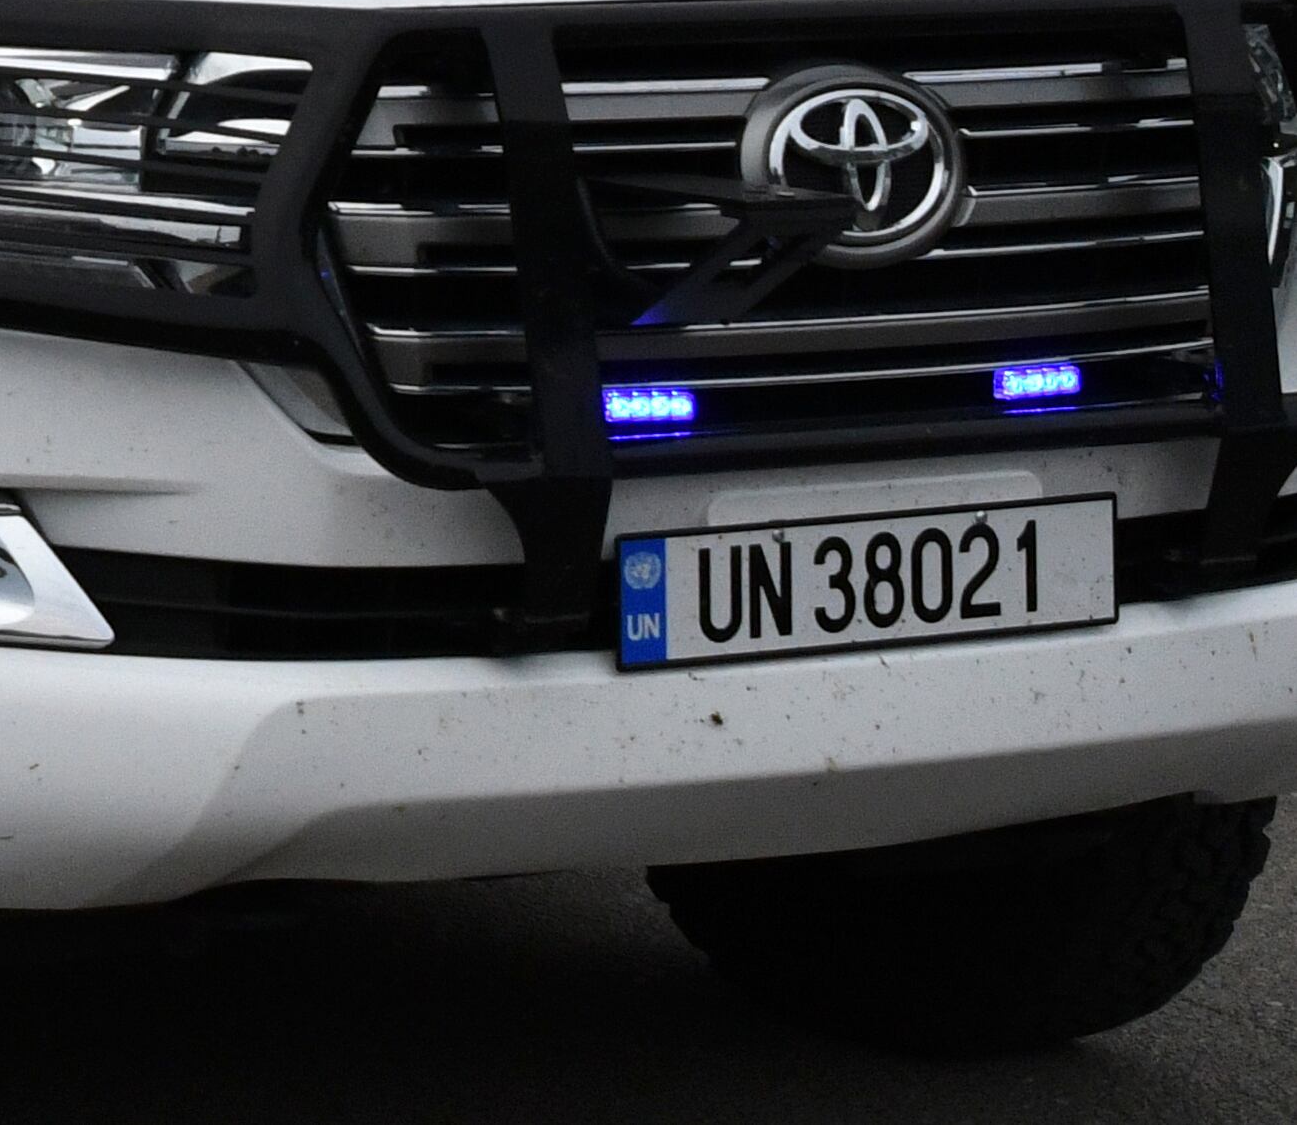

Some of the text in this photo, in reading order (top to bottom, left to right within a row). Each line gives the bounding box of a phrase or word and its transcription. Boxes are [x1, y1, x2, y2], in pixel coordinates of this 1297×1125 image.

[698, 518, 1038, 644] UN 38021
[626, 612, 661, 642] UN
